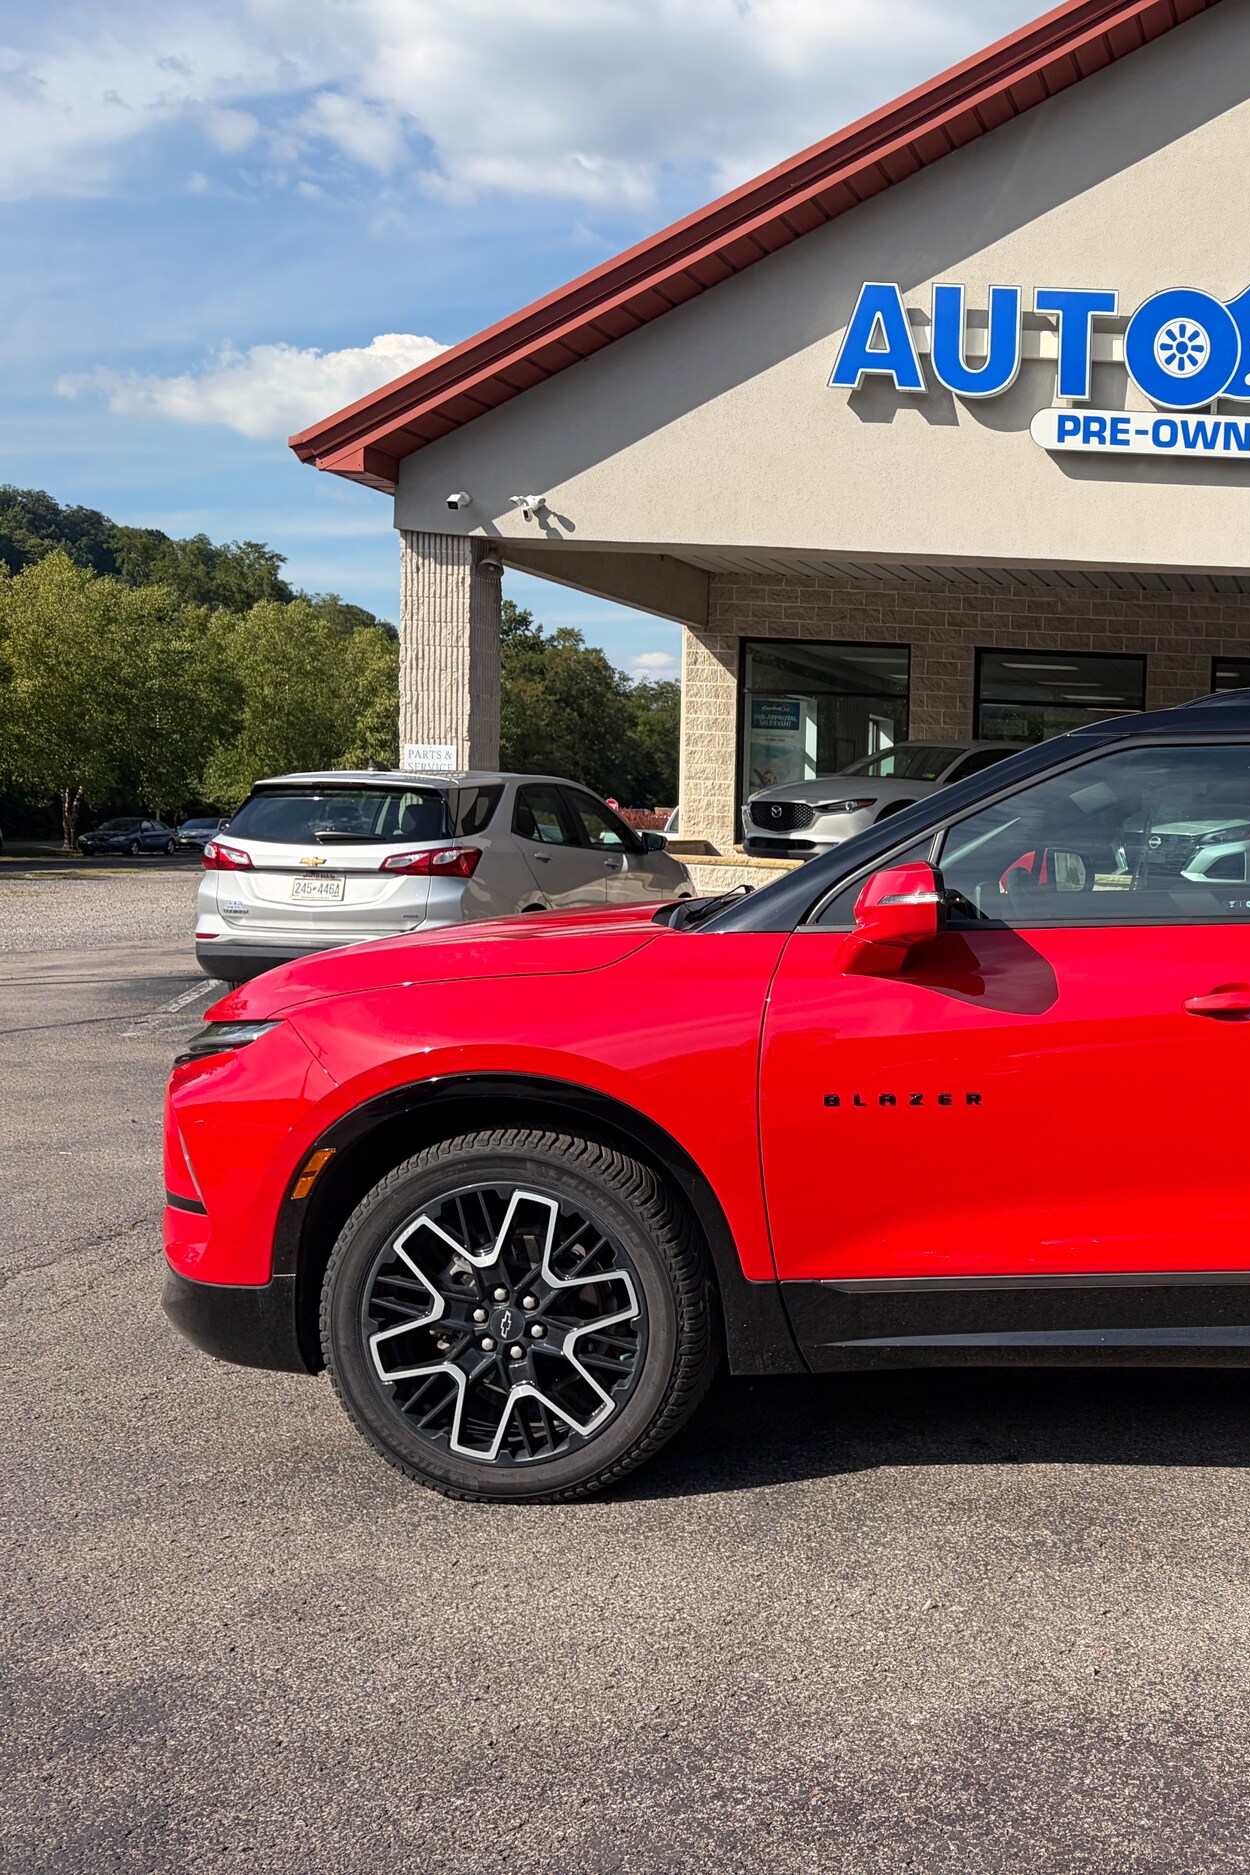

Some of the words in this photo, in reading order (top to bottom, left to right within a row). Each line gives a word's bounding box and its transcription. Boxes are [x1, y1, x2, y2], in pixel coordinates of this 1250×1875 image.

[827, 281, 1241, 410] AUTO
[408, 750, 442, 760] PARTS
[444, 750, 453, 760] &
[823, 1092, 983, 1107] BLAZER
